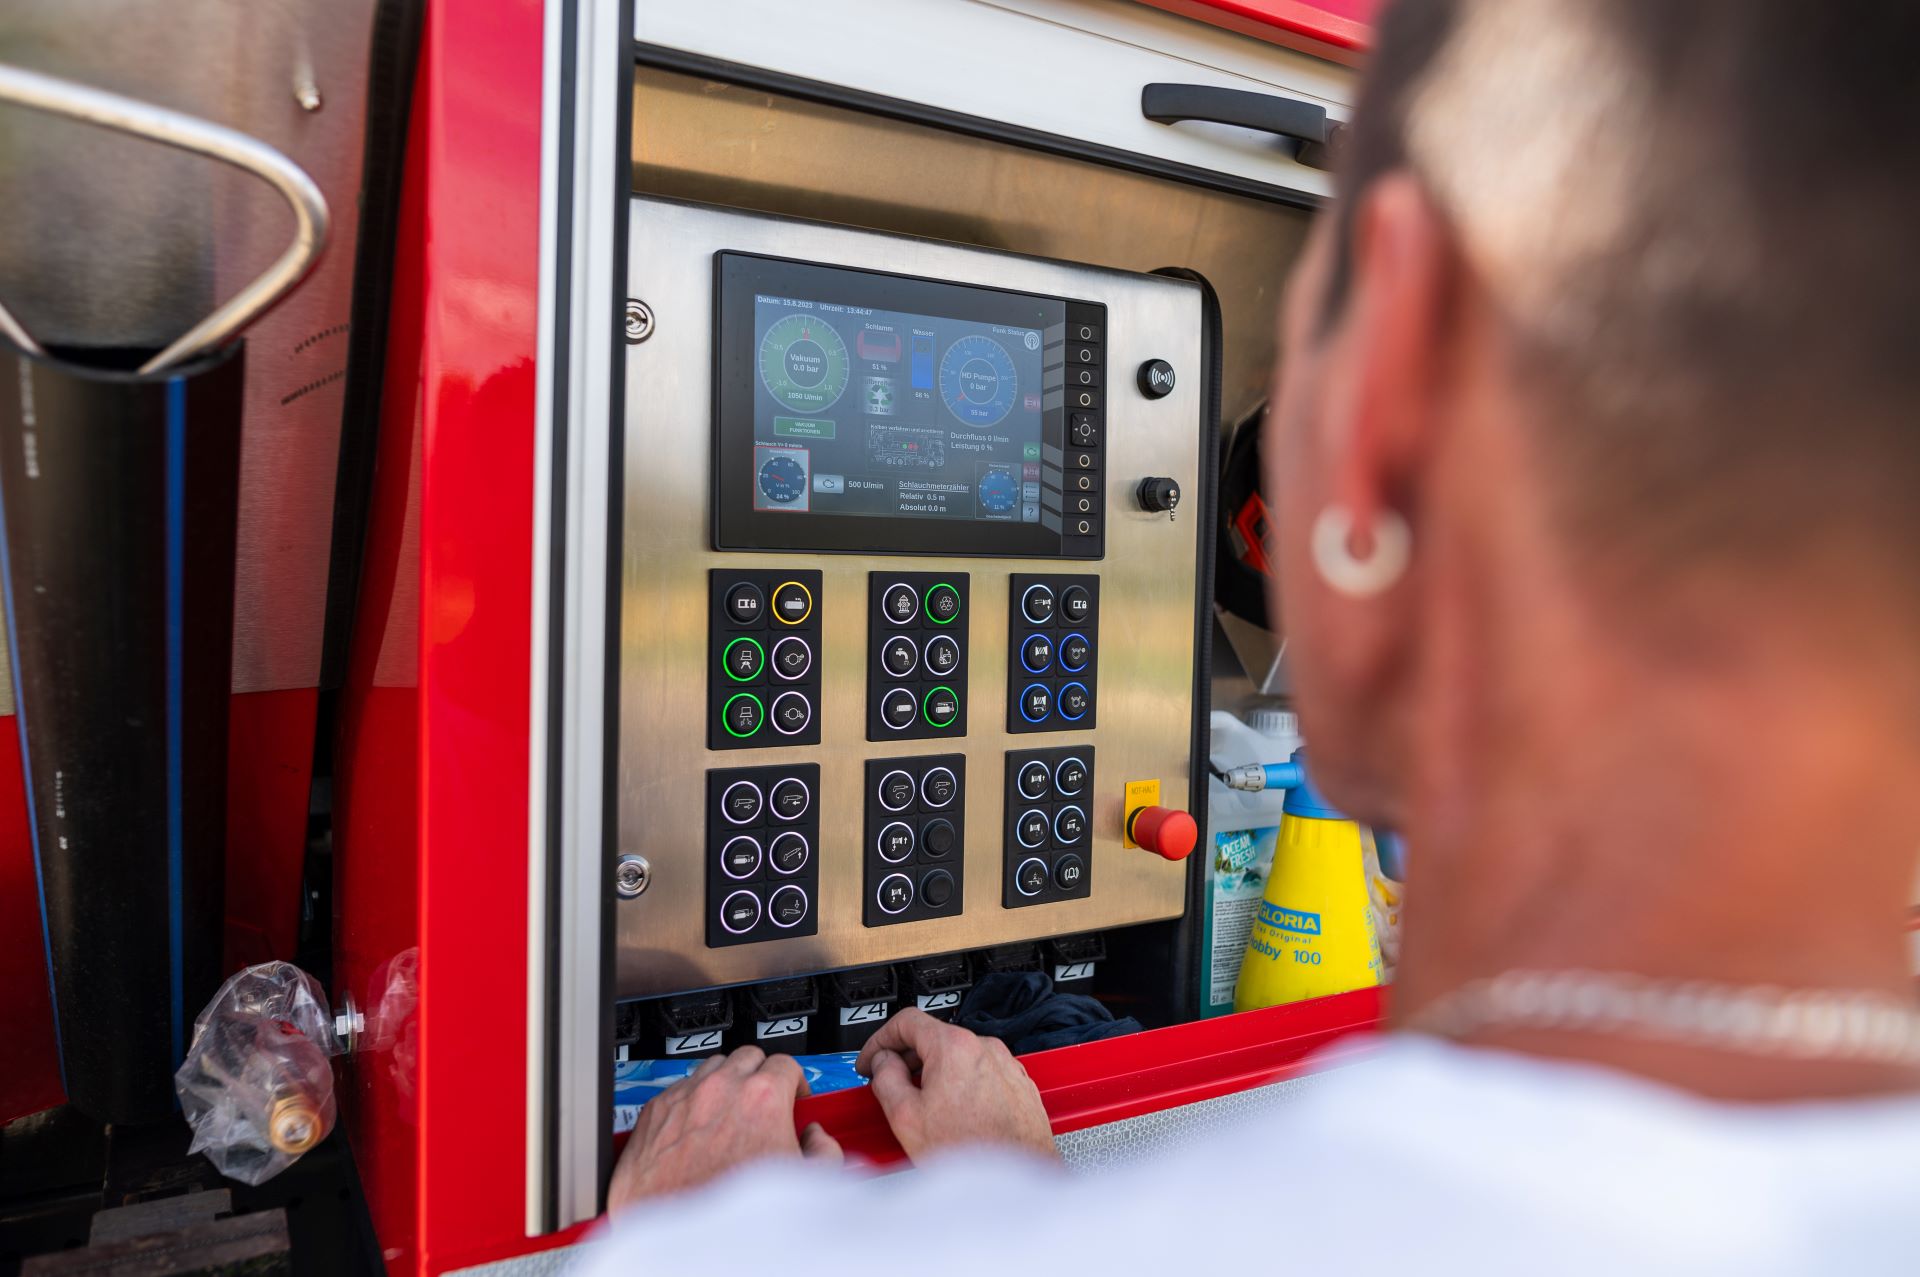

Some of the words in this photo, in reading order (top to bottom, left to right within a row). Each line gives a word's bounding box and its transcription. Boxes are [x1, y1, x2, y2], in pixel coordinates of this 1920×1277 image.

[758, 296, 781, 304] Datum:
[783, 299, 813, 309] 15.8.2023
[820, 303, 844, 313] Uhrzeit:
[847, 307, 873, 316] 13:44:47
[865, 323, 894, 332] Schlamm
[912, 328, 935, 337] Wasser
[1007, 328, 1025, 336] Status
[790, 353, 820, 363] Vakuum
[793, 364, 805, 372] 0.0
[806, 365, 819, 373] bar
[881, 363, 887, 371] %
[961, 371, 972, 379] HD
[973, 372, 996, 382] Pumpe
[975, 383, 987, 391] bar
[788, 392, 803, 400] 1050
[803, 393, 823, 401] U/min
[950, 432, 987, 441] Durchfluss
[951, 442, 980, 452] Leistung
[862, 482, 884, 490] U/min
[899, 481, 970, 491] Schlauchmeterzähler
[900, 492, 924, 500] Relativ
[900, 503, 926, 511] Absolut
[928, 504, 938, 512] 0.0
[1223, 834, 1251, 860] OCEAN
[1230, 846, 1256, 869] FRESH
[1259, 904, 1319, 931] GLORIA
[1269, 929, 1313, 945] Original
[1293, 949, 1321, 965] 100
[848, 1001, 886, 1021] Z4
[763, 1016, 804, 1036] Z3
[675, 1031, 719, 1051] Z2
